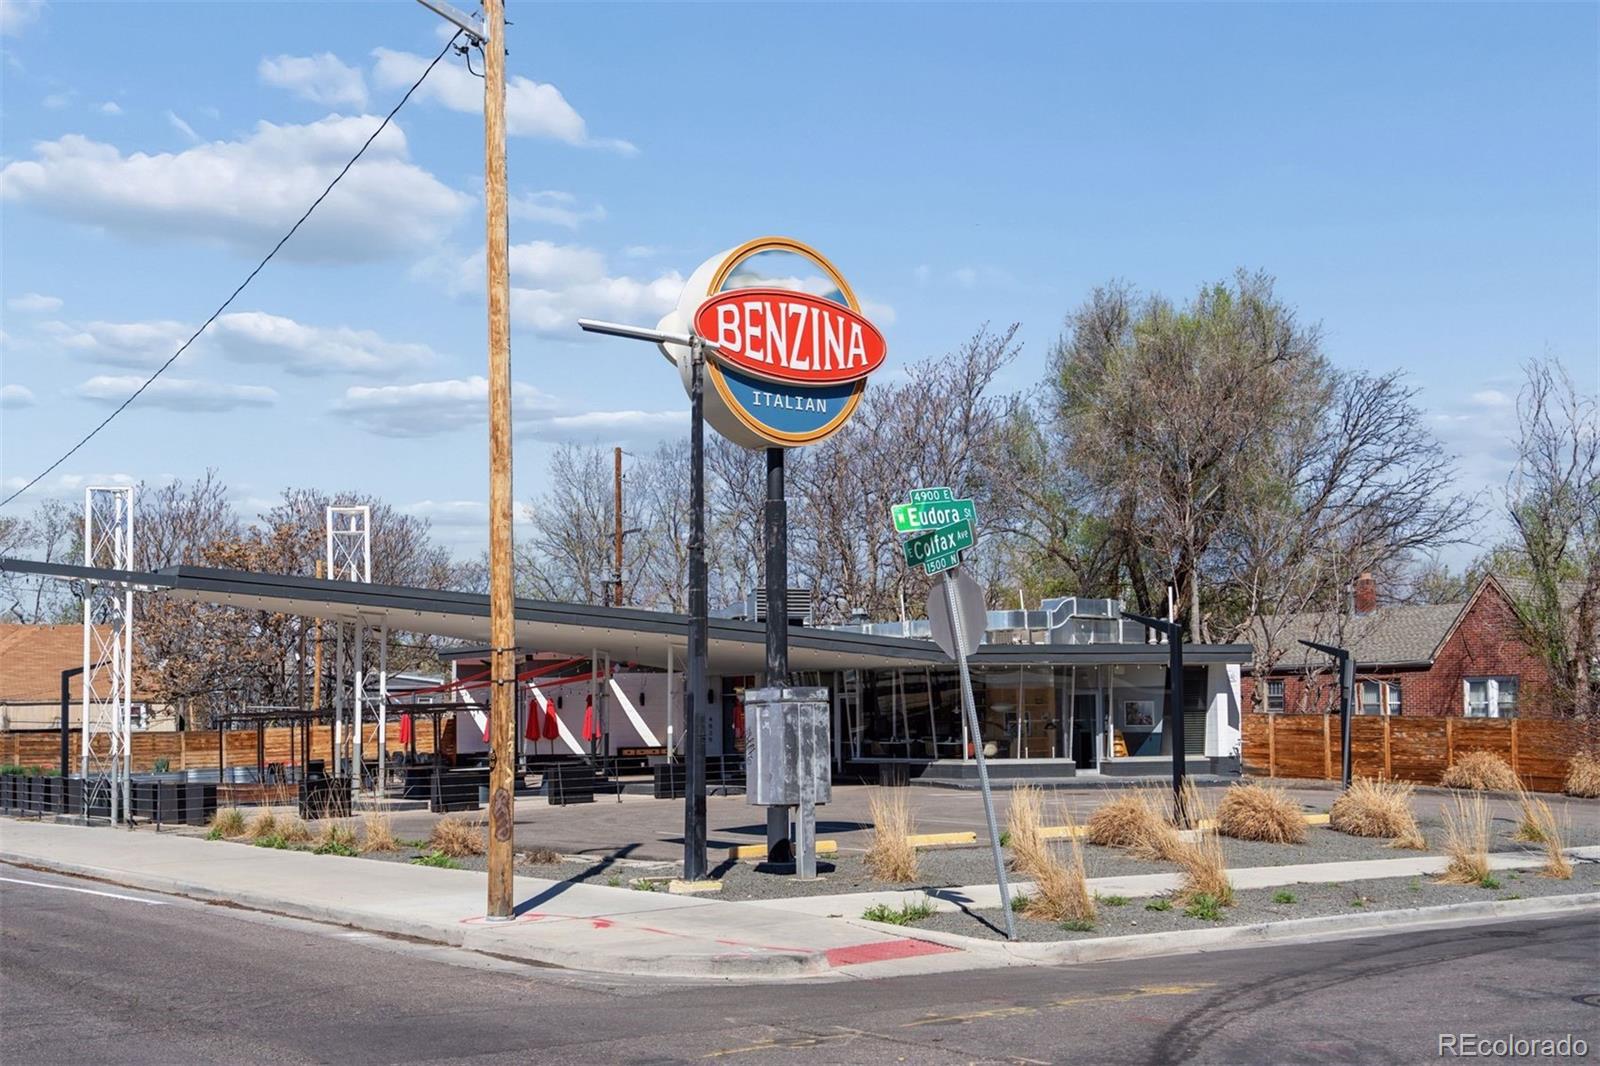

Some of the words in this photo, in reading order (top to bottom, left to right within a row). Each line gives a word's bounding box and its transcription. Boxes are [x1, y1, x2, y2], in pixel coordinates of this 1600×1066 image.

[716, 301, 869, 371] BENZINA
[753, 391, 827, 413] ITALIAN
[914, 490, 940, 502] 4900
[943, 490, 950, 499] E
[908, 508, 959, 527] Eudora
[914, 533, 956, 559] Colfax
[957, 530, 968, 540] Ave
[927, 559, 946, 572] 1500
[951, 555, 957, 564] N
